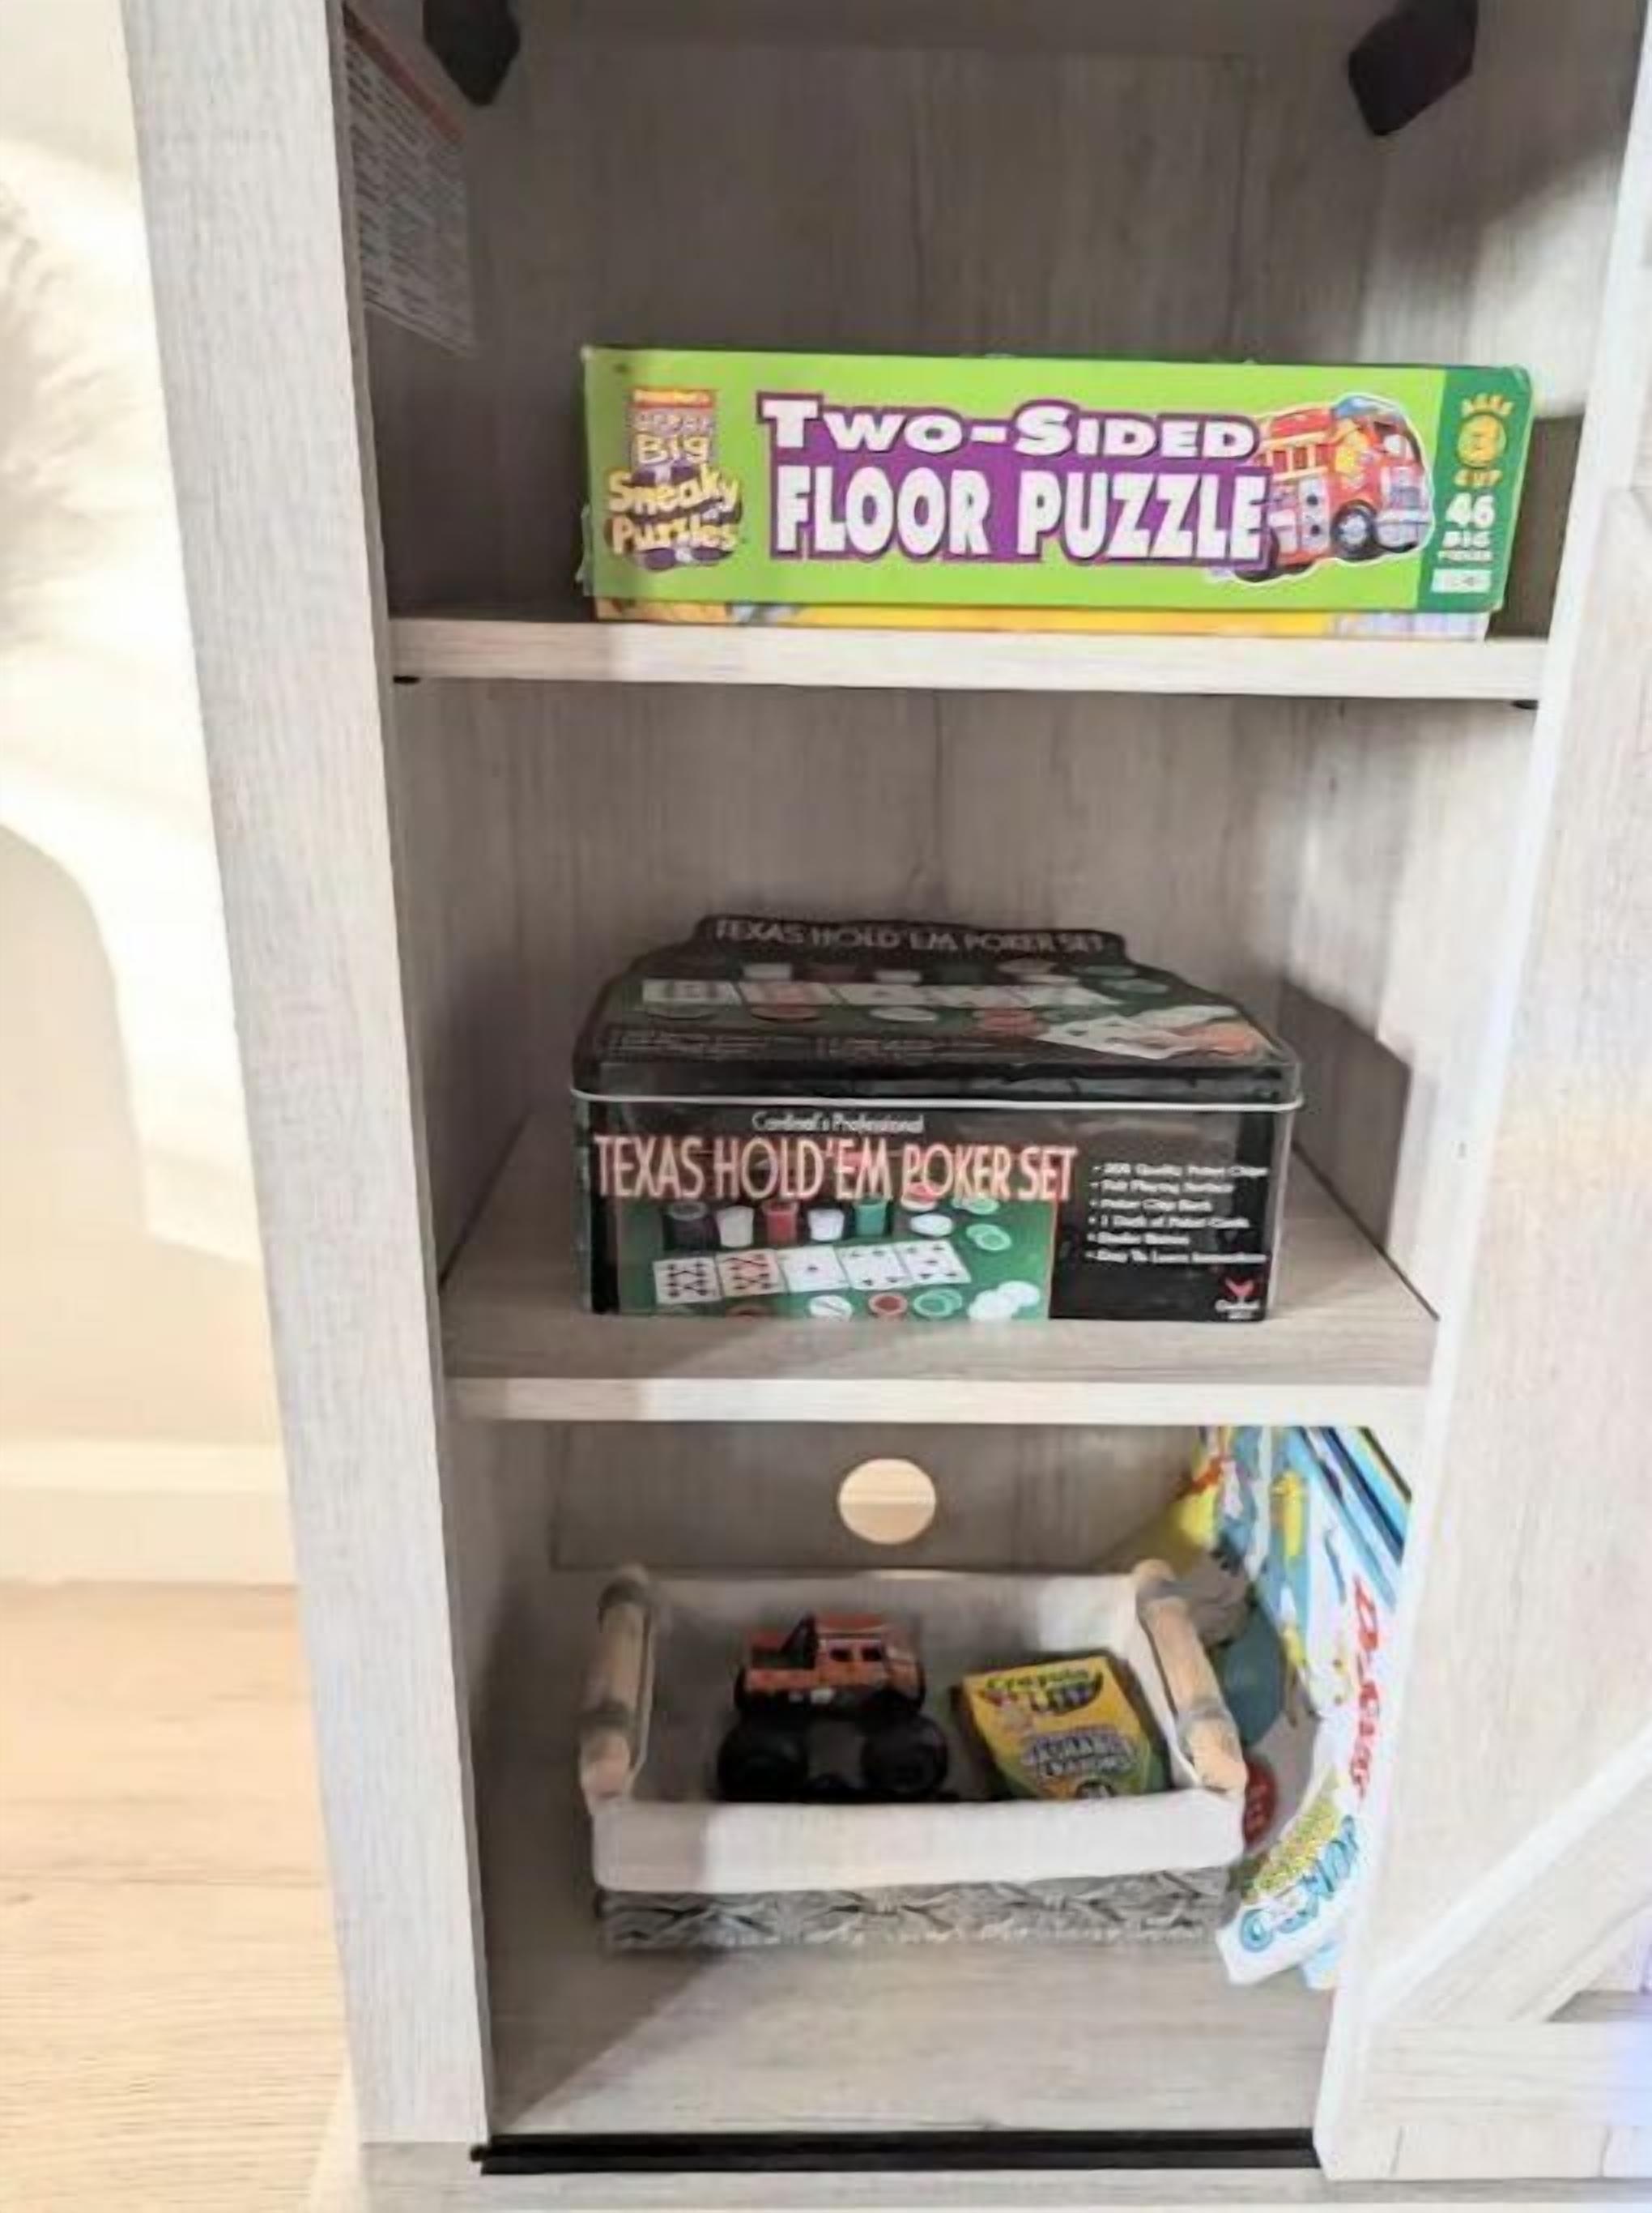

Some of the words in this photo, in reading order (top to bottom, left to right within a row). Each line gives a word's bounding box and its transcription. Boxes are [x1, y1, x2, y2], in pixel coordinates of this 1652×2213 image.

[636, 433, 710, 466] Big
[607, 460, 740, 513] Sneaky
[775, 466, 991, 556] FLOOR
[1017, 469, 1267, 560] PUZZLE
[1446, 492, 1496, 529] 46
[611, 513, 738, 556] Puzzles
[716, 918, 805, 944] TEXAS
[594, 1135, 705, 1198] TEXAS
[901, 1141, 1011, 1202] POKER
[1017, 1145, 1077, 1201] SET
